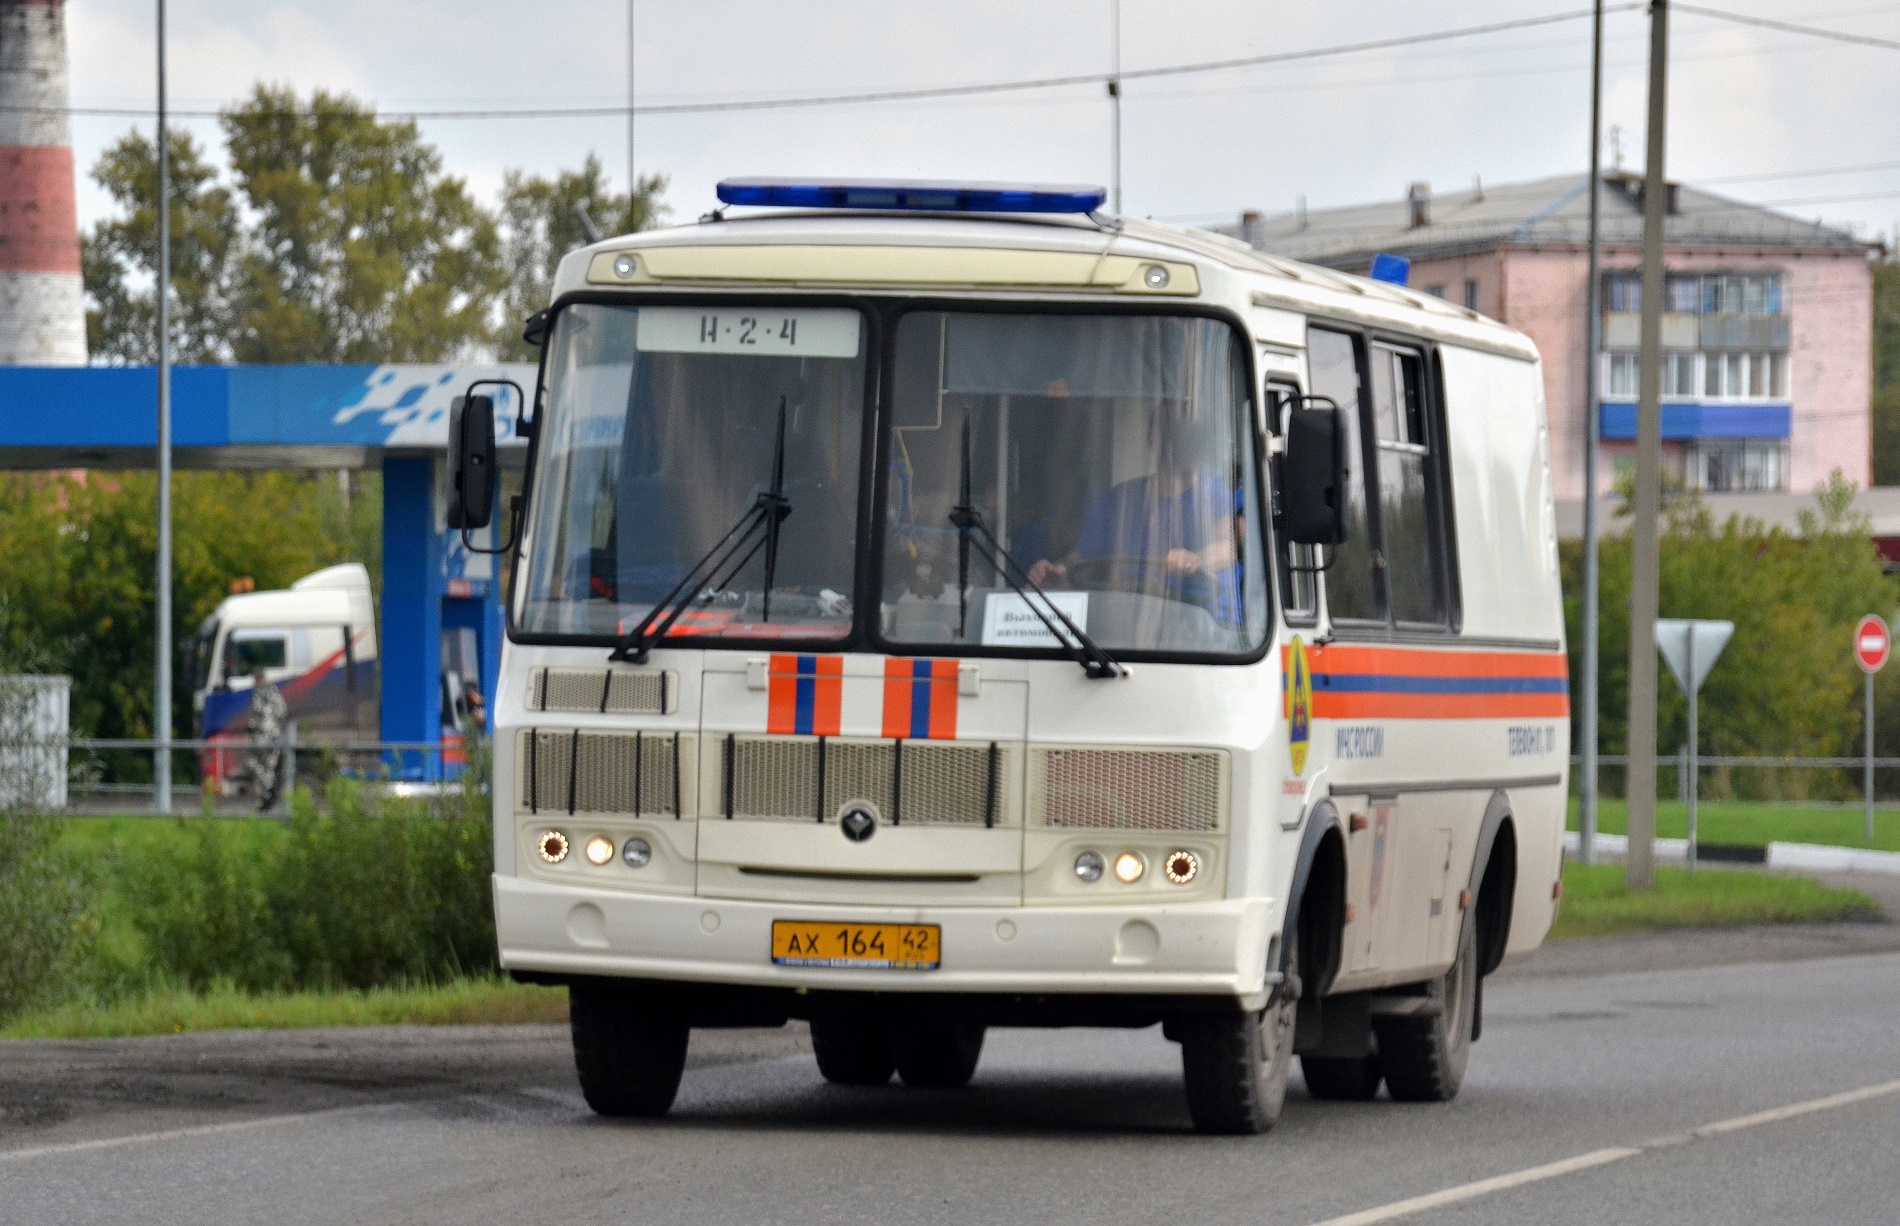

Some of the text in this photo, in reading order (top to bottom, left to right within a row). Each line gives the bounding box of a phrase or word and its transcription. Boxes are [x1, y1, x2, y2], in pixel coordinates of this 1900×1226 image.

[788, 929, 929, 956] АХ 164 42
